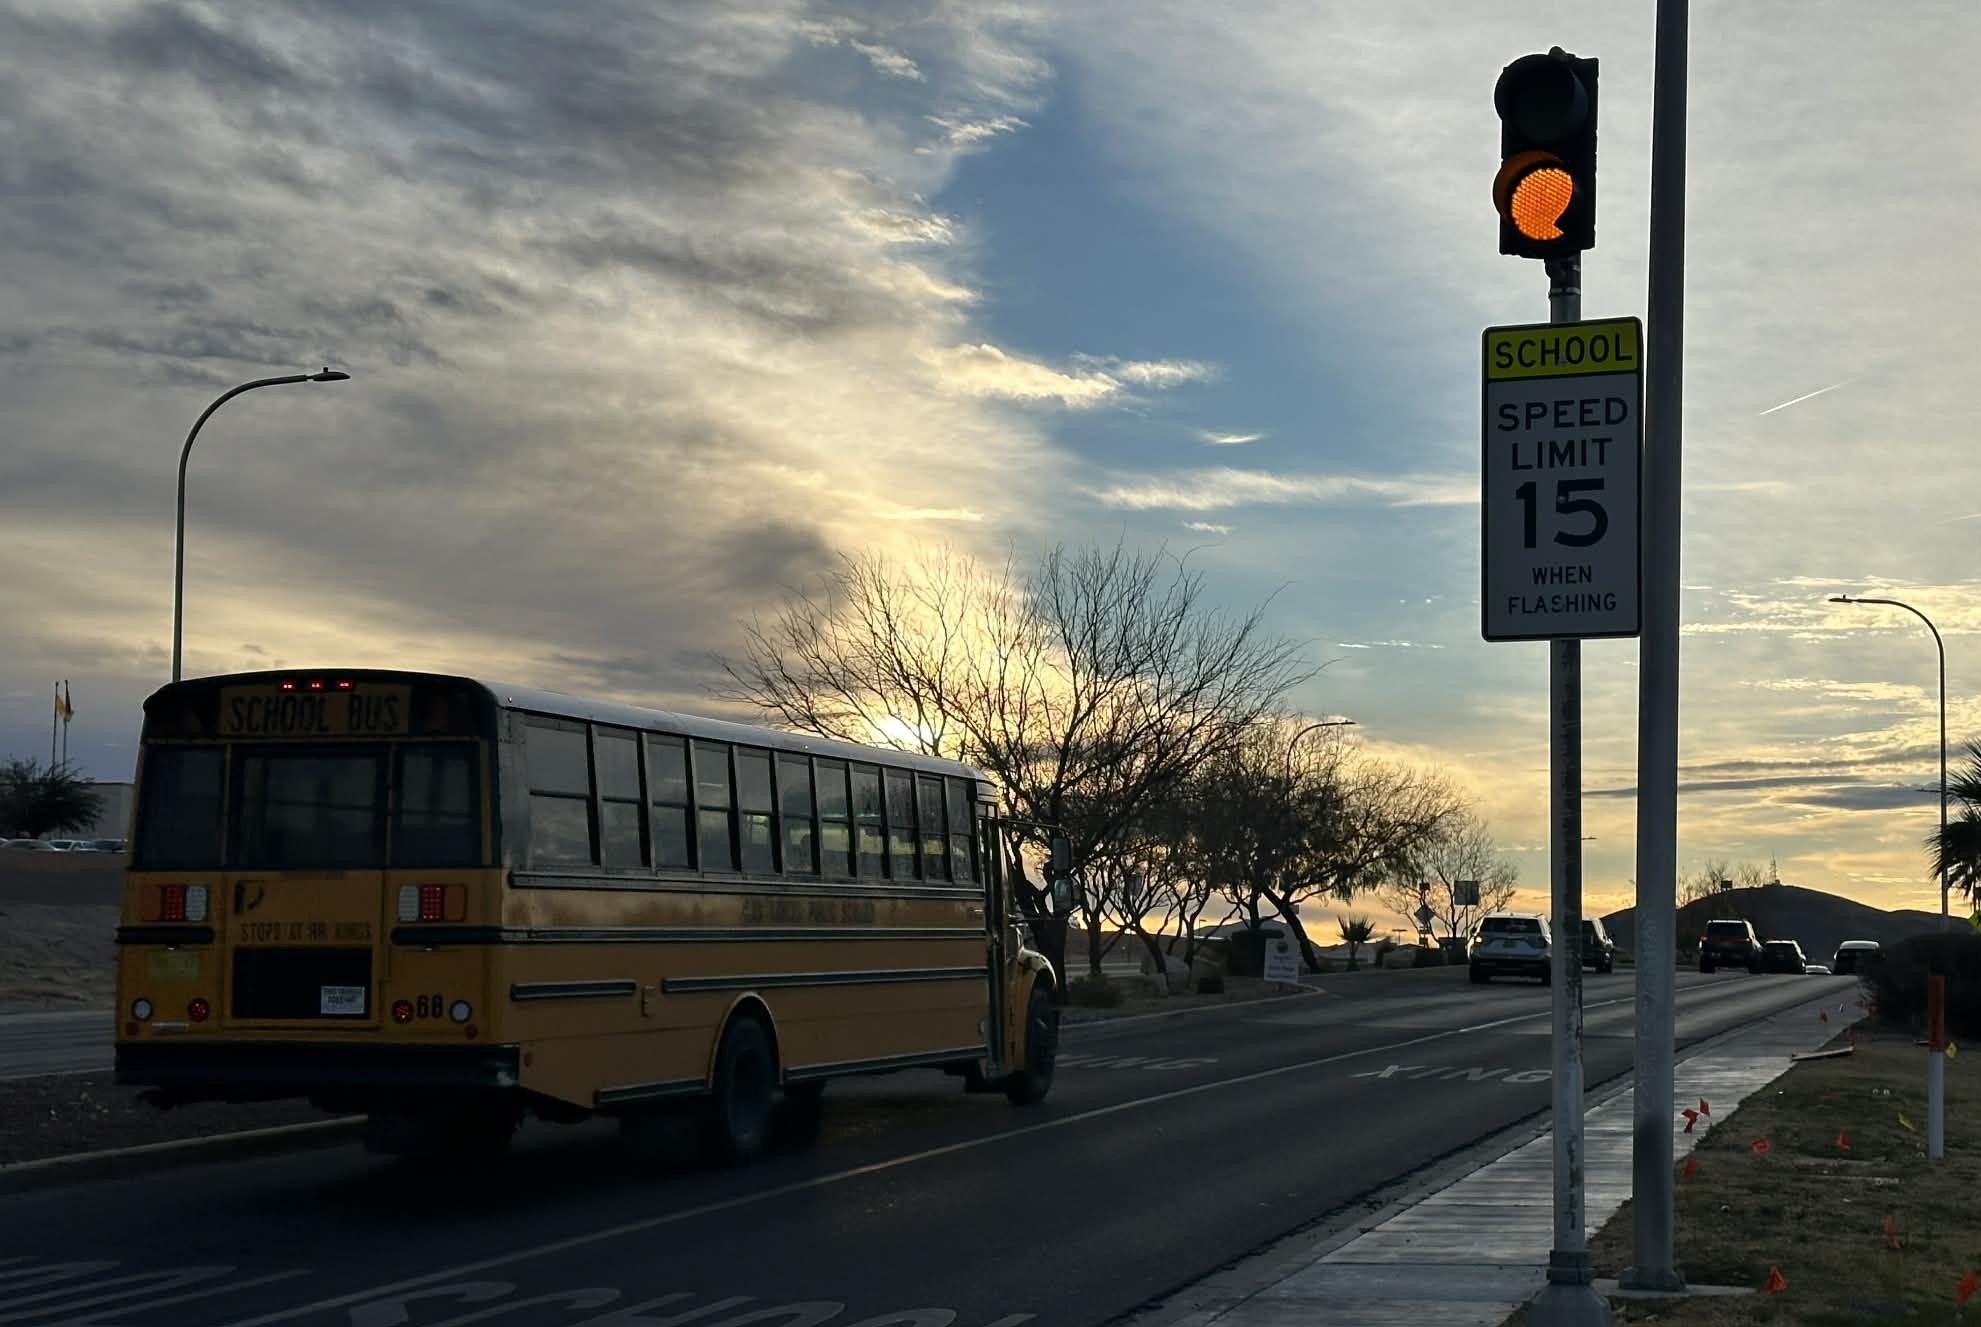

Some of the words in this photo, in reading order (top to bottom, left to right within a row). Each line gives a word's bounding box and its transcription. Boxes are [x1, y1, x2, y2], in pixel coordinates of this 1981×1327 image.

[1495, 333, 1633, 369] SCHOOL
[1498, 397, 1628, 432] SPEED
[1511, 438, 1613, 471] LIMIT
[1515, 478, 1608, 549] 15
[1532, 565, 1592, 585] WHEN
[1508, 593, 1617, 616] FLASHING
[231, 695, 330, 733] SCHOOL
[348, 694, 400, 731] BUS
